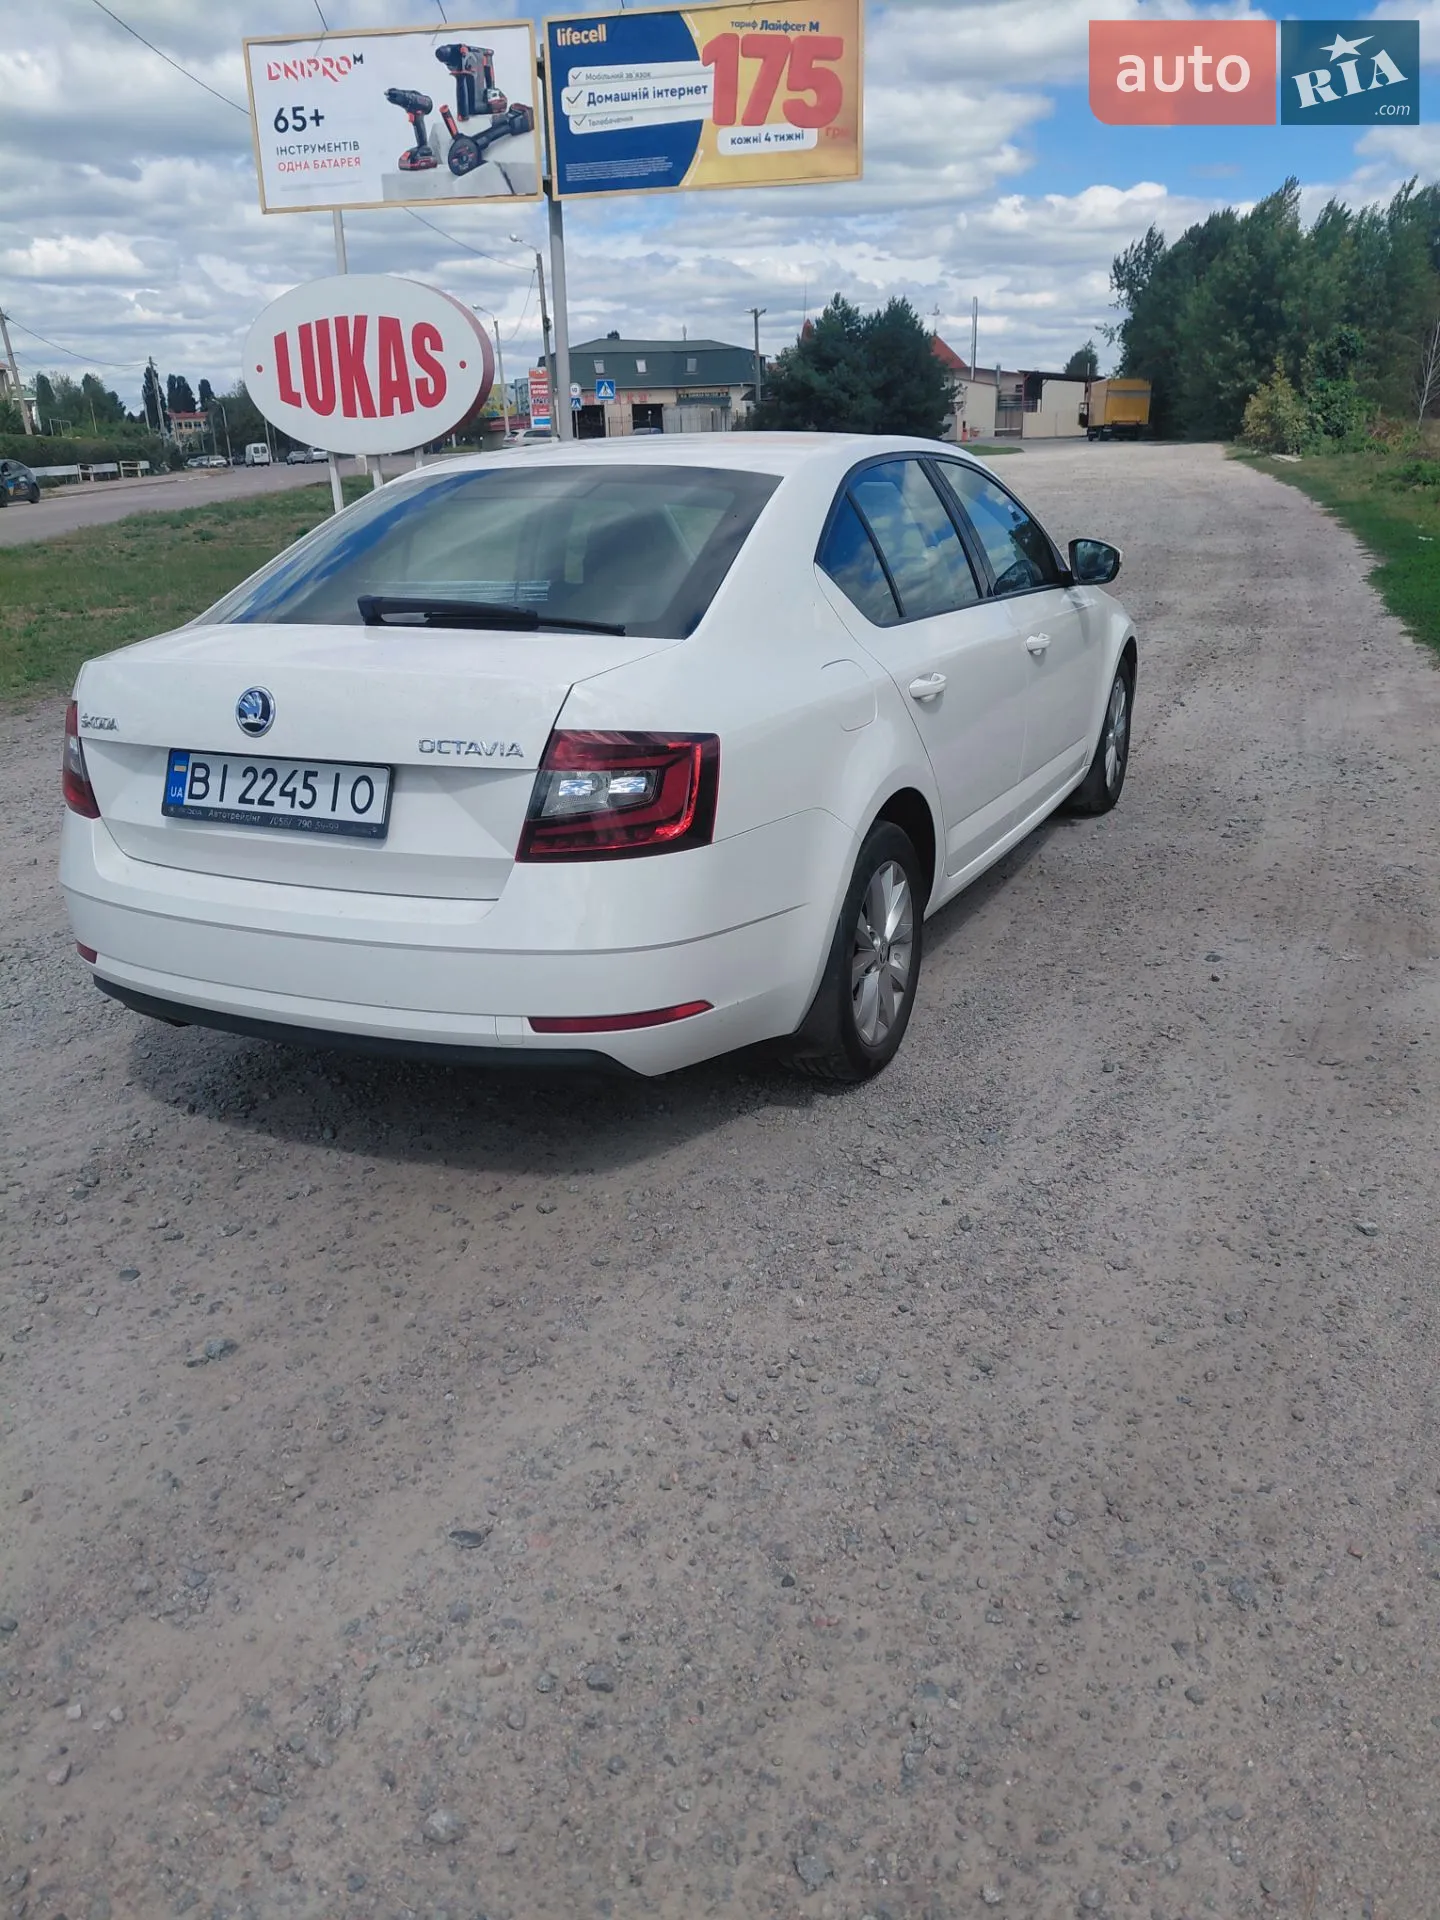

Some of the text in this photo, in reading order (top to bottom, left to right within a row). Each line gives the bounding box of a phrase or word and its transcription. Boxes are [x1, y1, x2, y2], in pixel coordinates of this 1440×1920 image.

[556, 23, 607, 47] lifecell
[730, 20, 759, 31] тариф
[759, 19, 806, 33] Лайфсет
[267, 55, 353, 83] DNIPRO
[701, 32, 844, 129] 175
[586, 83, 709, 107] Домашній інтернет
[273, 105, 325, 133] 65+
[275, 140, 360, 156] ІНСТРУМЕНТІВ
[730, 130, 805, 145] кожні 4 тижні
[277, 156, 361, 173] ОДНА БАТАРЕЯ
[273, 315, 448, 419] LUKAS
[418, 739, 524, 758] OCTAVIA
[170, 786, 184, 799] UA
[187, 762, 229, 802] BI
[238, 766, 319, 810] 2245
